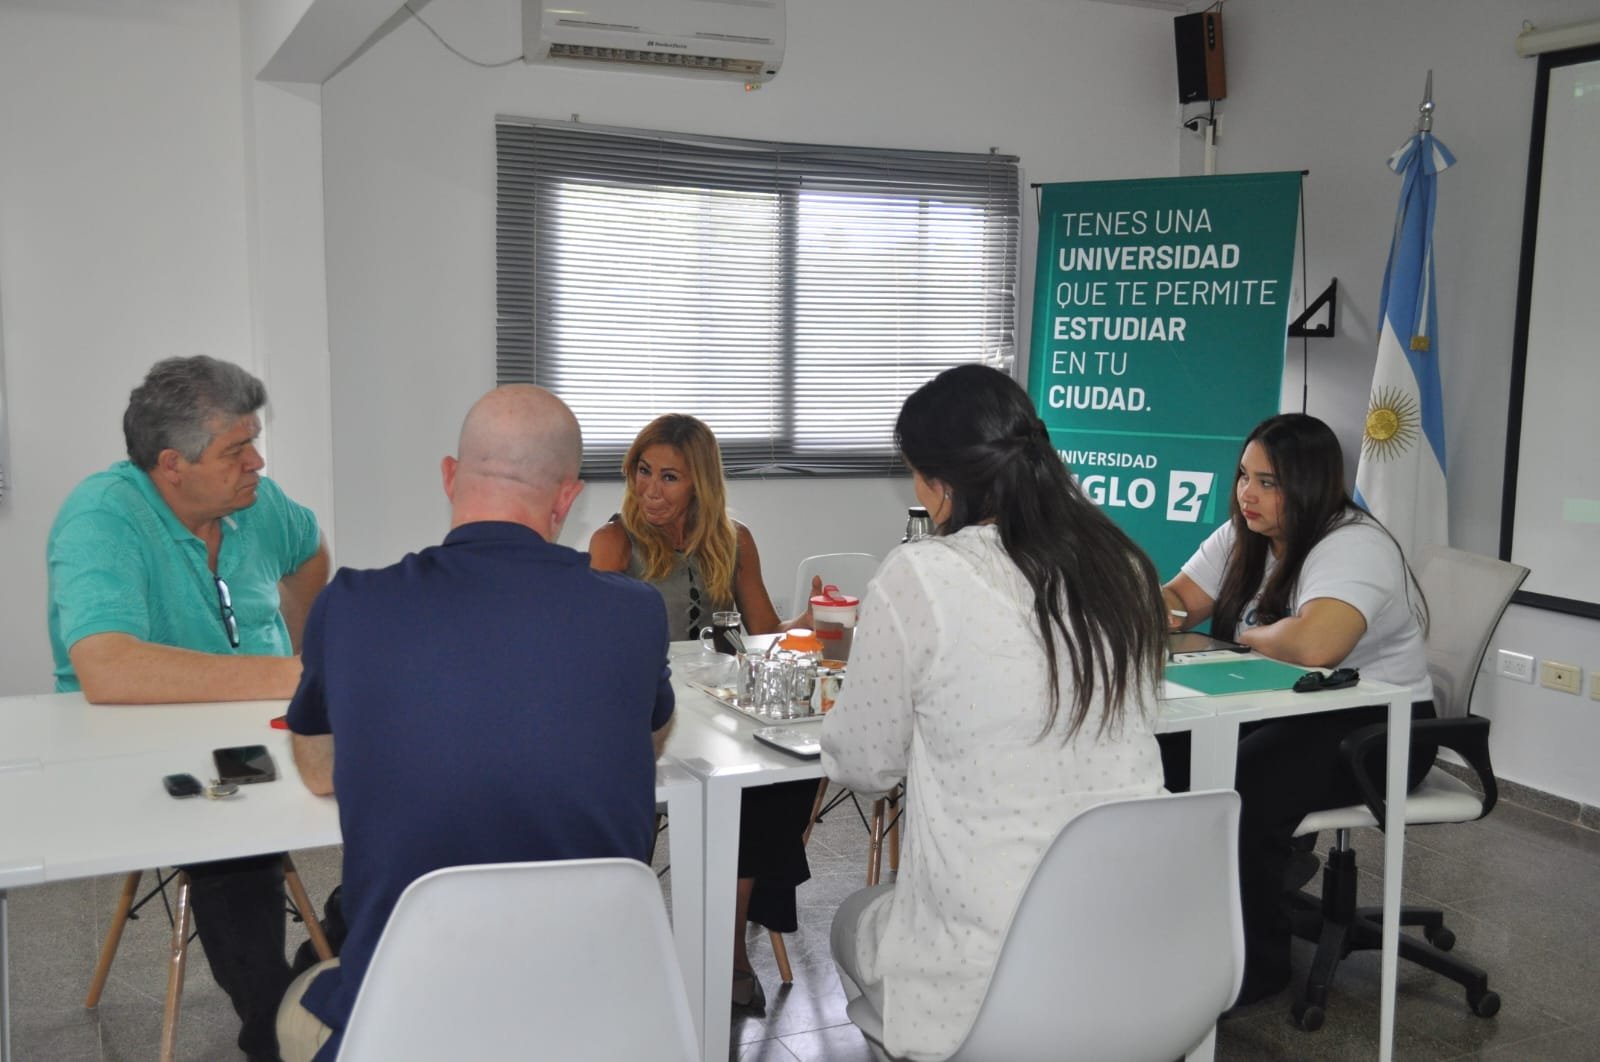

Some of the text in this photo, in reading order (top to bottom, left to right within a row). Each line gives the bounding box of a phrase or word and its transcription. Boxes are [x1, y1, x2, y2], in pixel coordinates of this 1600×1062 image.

[1061, 208, 1213, 237] TENES UNA
[1058, 243, 1240, 272] UNIVERSIDAD
[1056, 279, 1278, 309] QUE TE PERMITE
[1053, 316, 1187, 342] ESTUDIAR
[1052, 351, 1128, 376] EN TU
[1048, 385, 1152, 412] CIUDAD.
[1070, 472, 1157, 510] GLO
